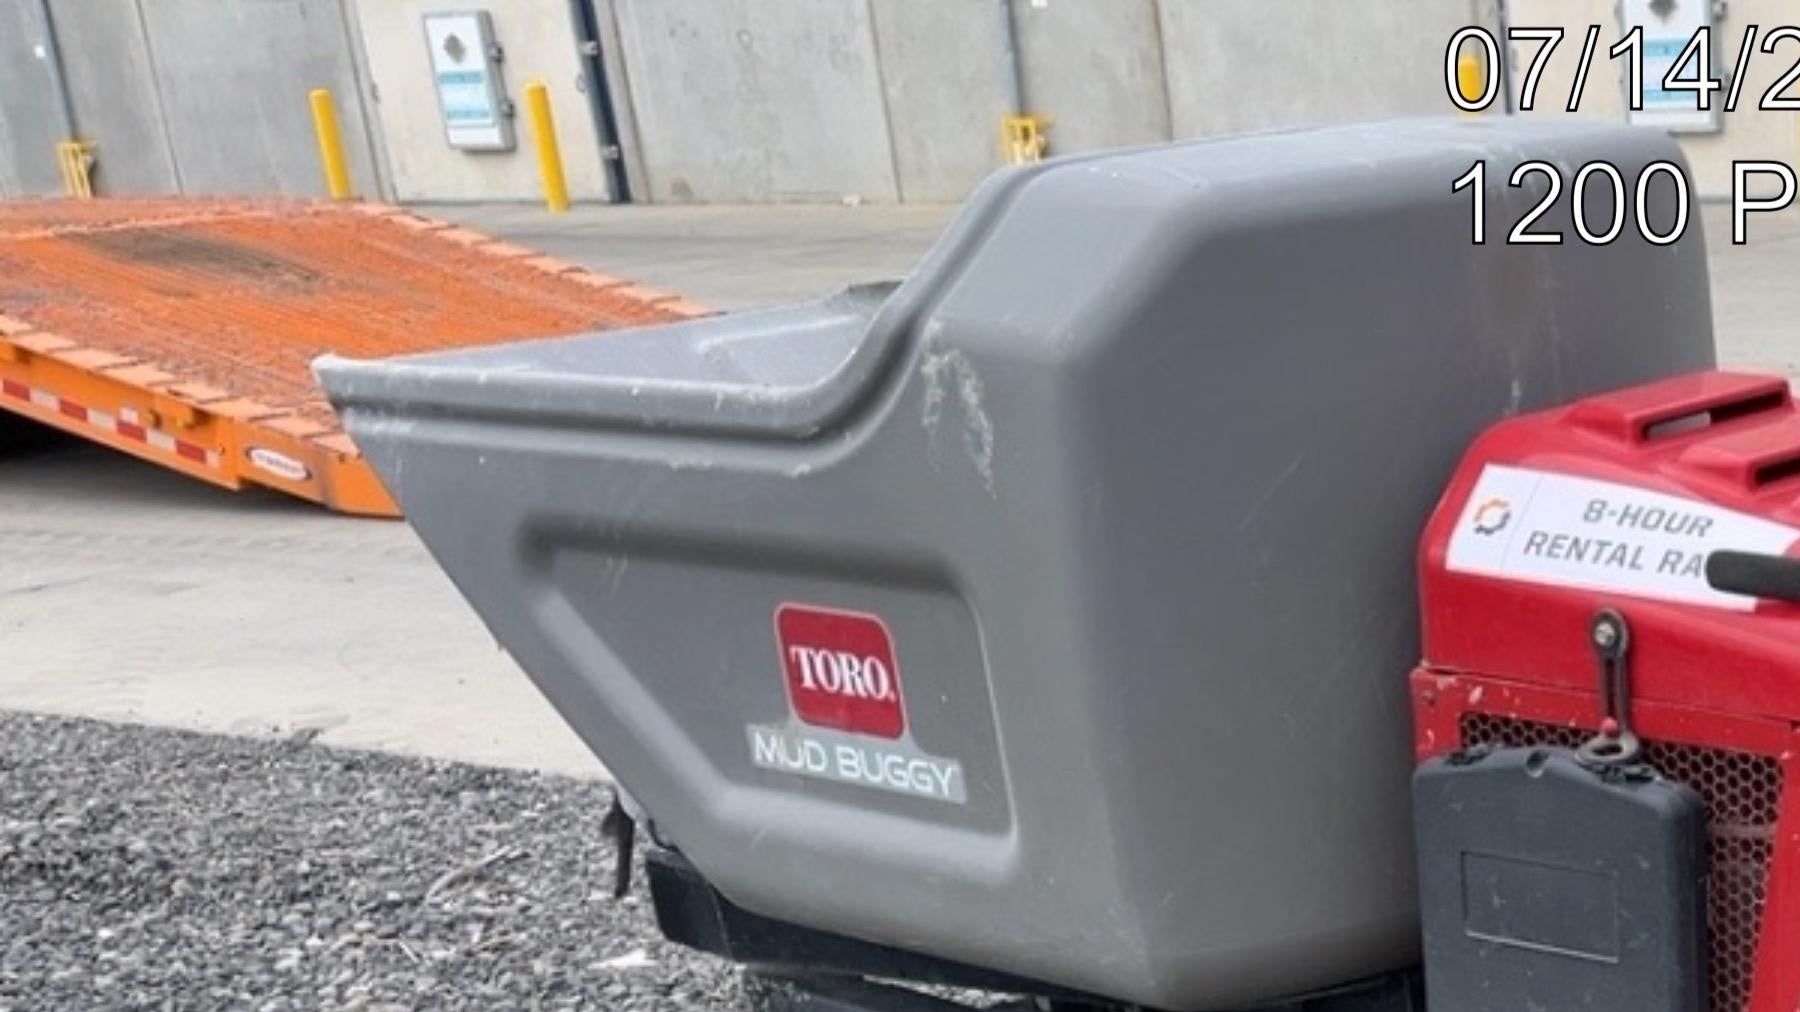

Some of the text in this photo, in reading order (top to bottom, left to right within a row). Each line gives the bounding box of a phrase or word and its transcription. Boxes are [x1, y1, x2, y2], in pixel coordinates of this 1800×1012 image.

[1583, 498, 1714, 538] 8-HOUR
[1523, 530, 1646, 572] RENTAL
[754, 731, 952, 797] MUD BUGGY
